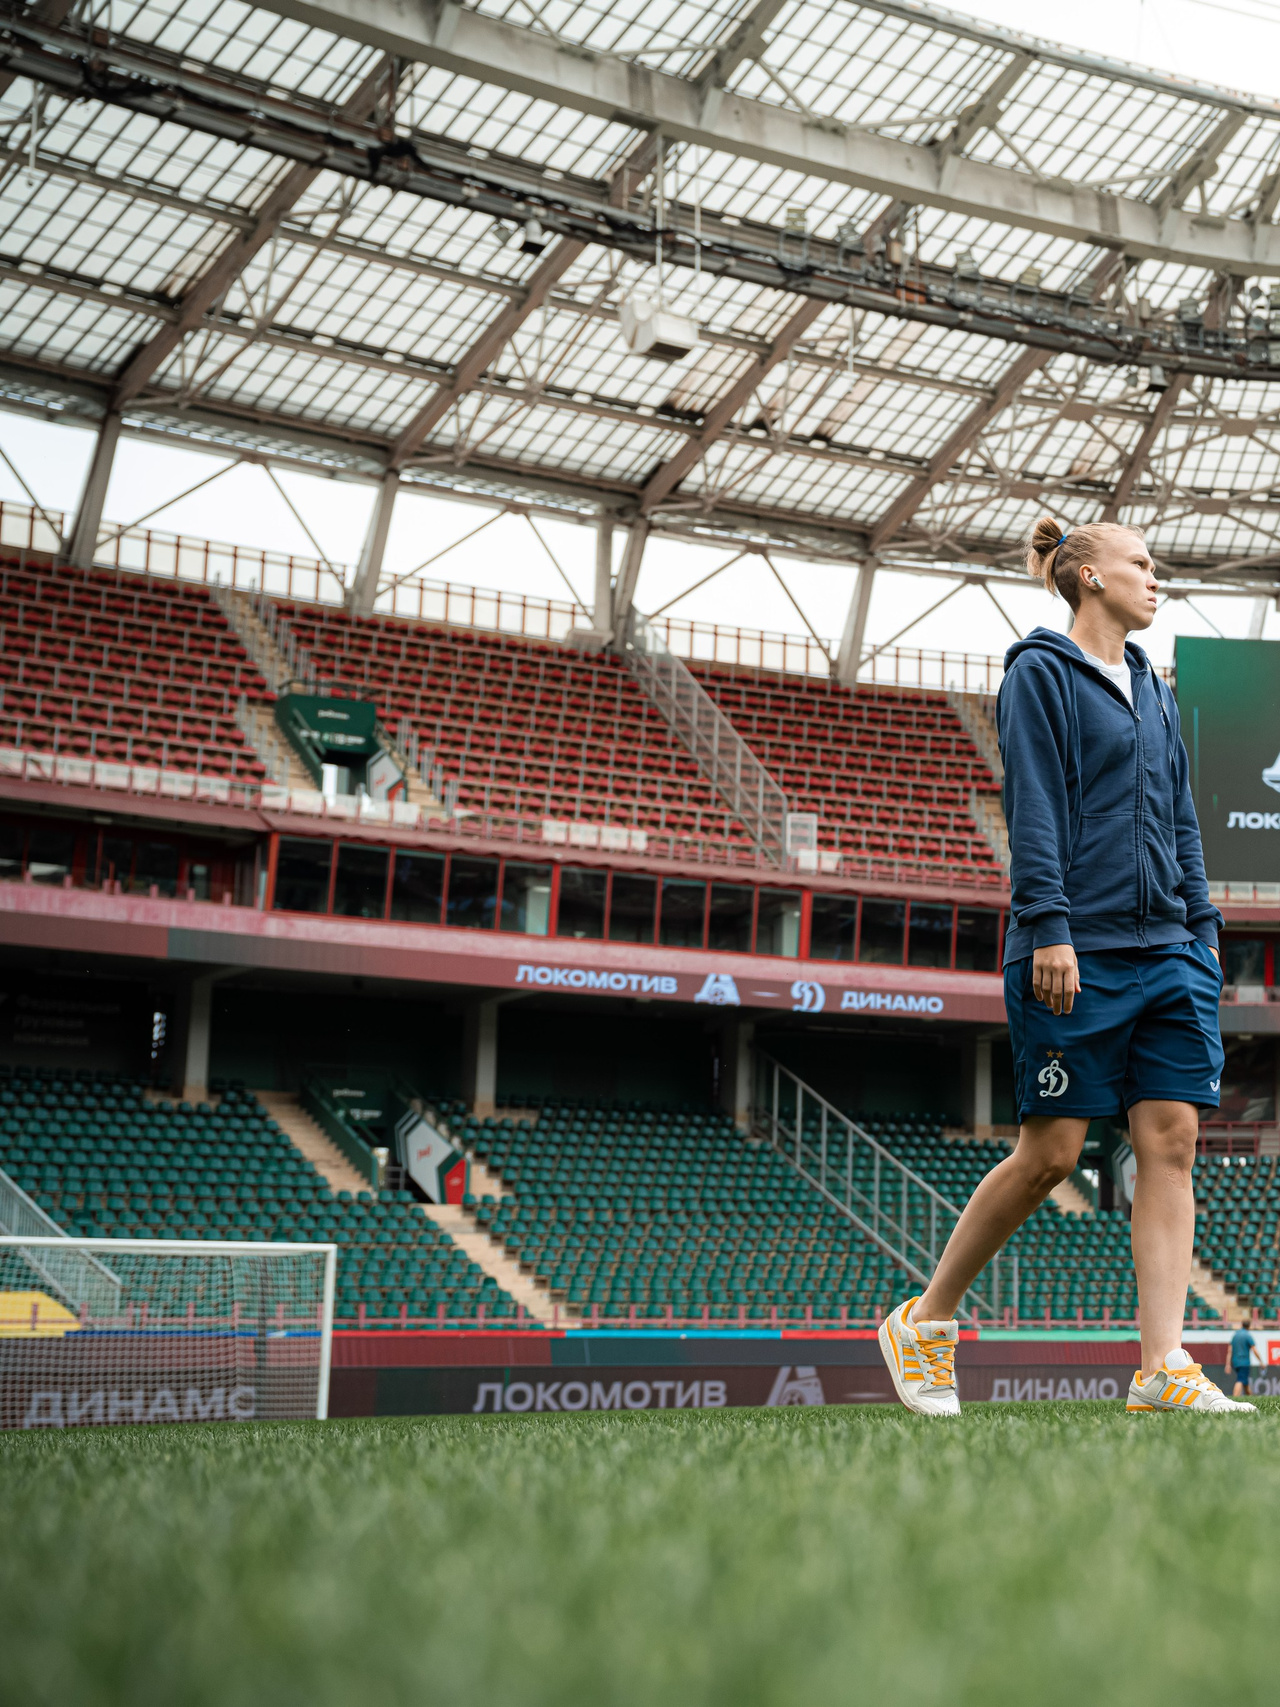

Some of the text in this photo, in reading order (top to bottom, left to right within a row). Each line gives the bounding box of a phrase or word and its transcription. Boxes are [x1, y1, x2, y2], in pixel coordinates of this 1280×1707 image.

[516, 964, 678, 994] ЛОКОМОТИВ
[840, 990, 944, 1014] ДИНАМО
[473, 1380, 727, 1412] ЛОКОМОТИВ
[991, 1378, 1119, 1401] ДИНАМО
